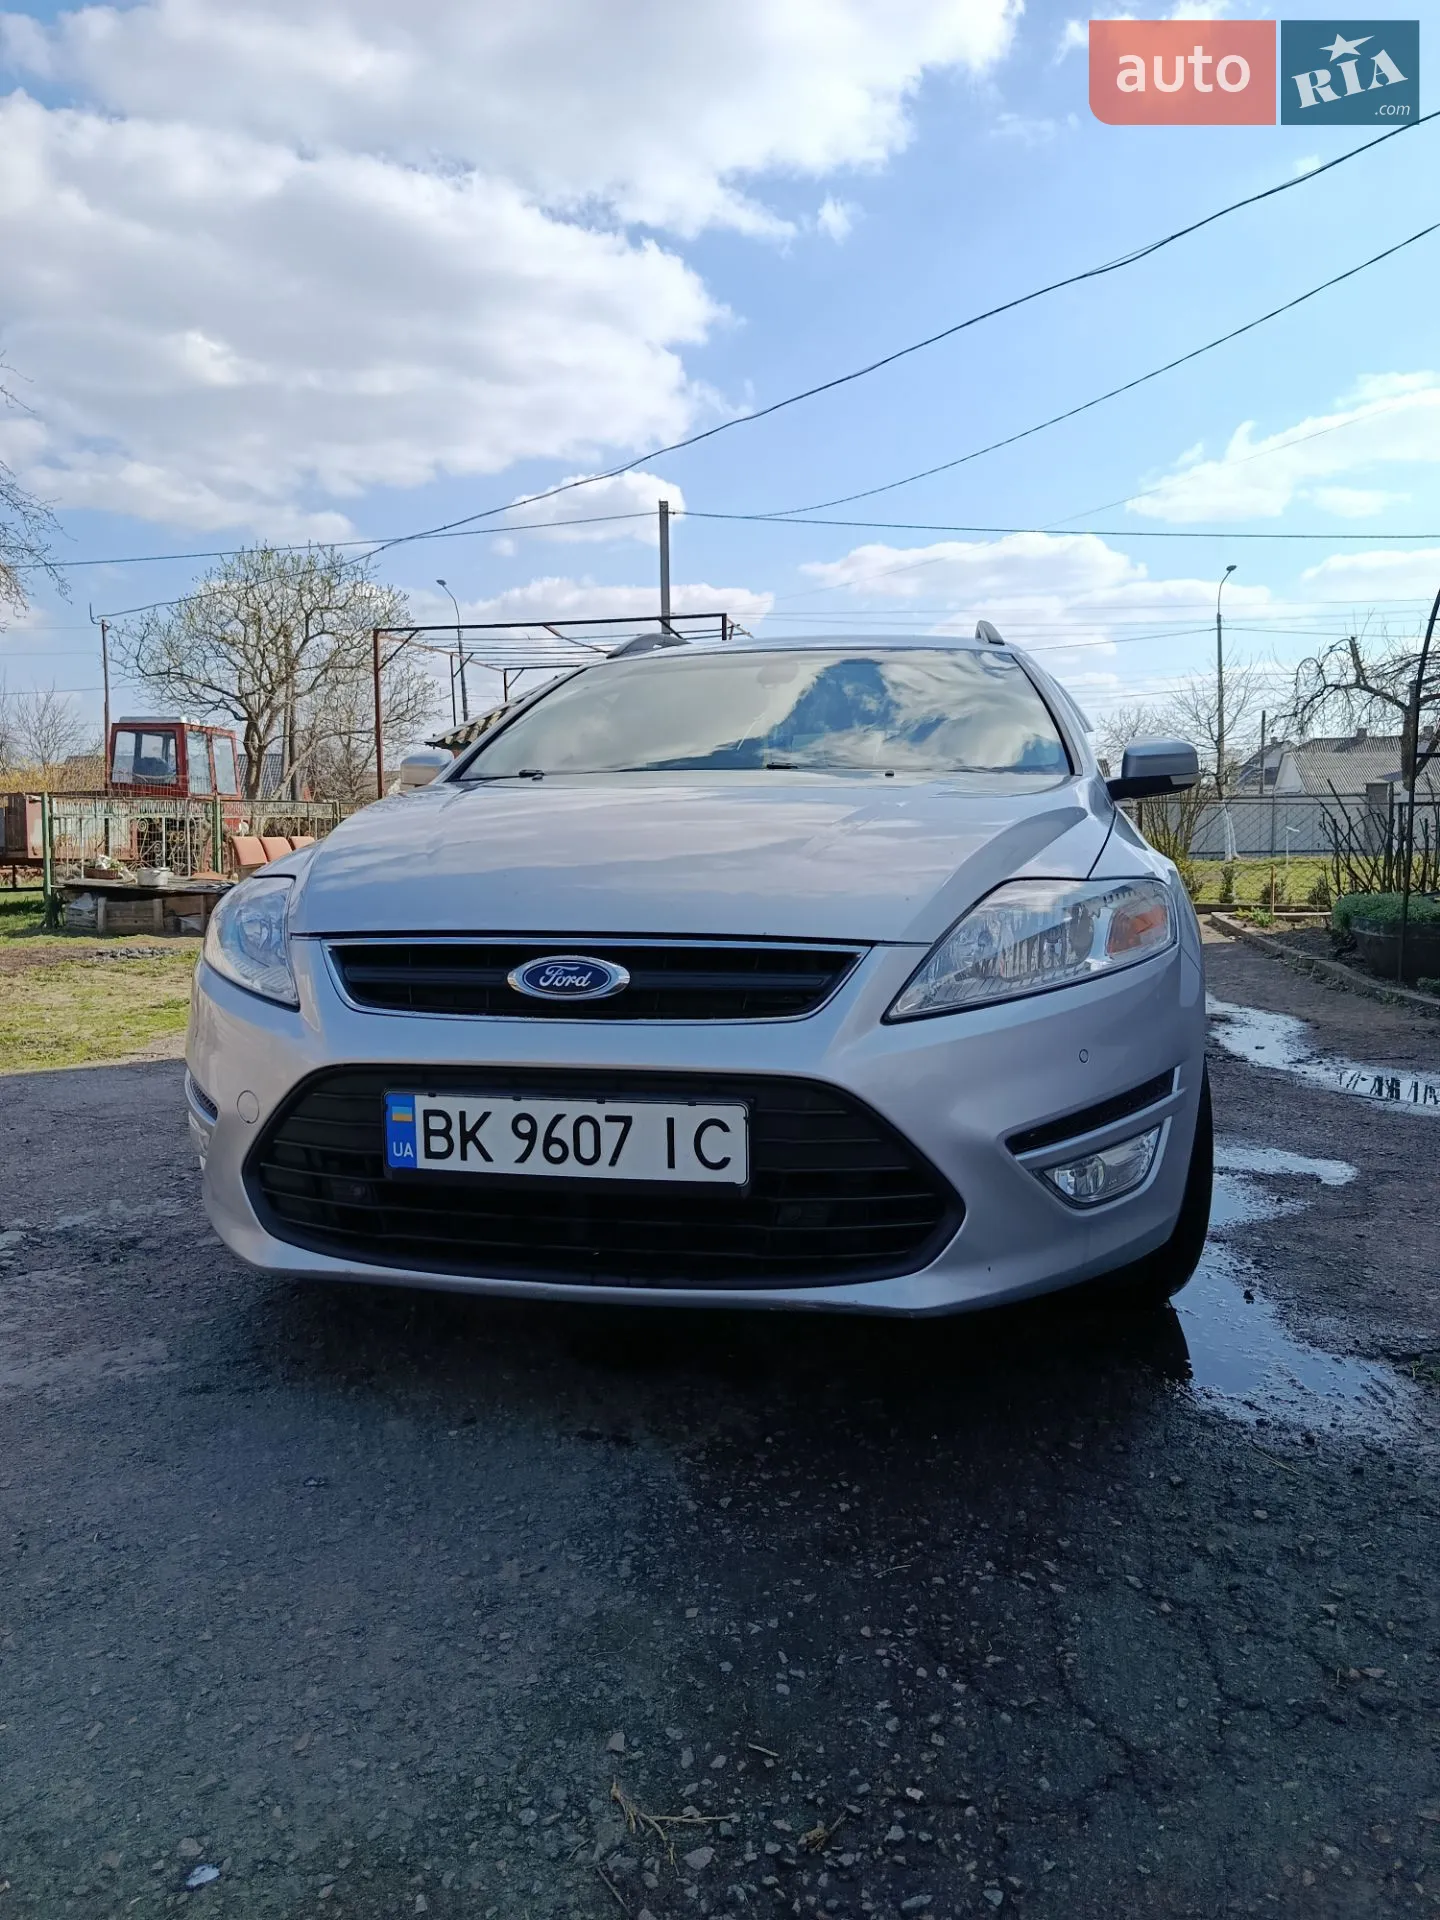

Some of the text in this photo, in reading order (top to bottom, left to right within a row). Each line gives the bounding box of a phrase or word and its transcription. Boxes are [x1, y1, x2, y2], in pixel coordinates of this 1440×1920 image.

[539, 965, 593, 987] Ford
[392, 1142, 414, 1158] UA
[422, 1109, 732, 1171] BK 9607 IC
